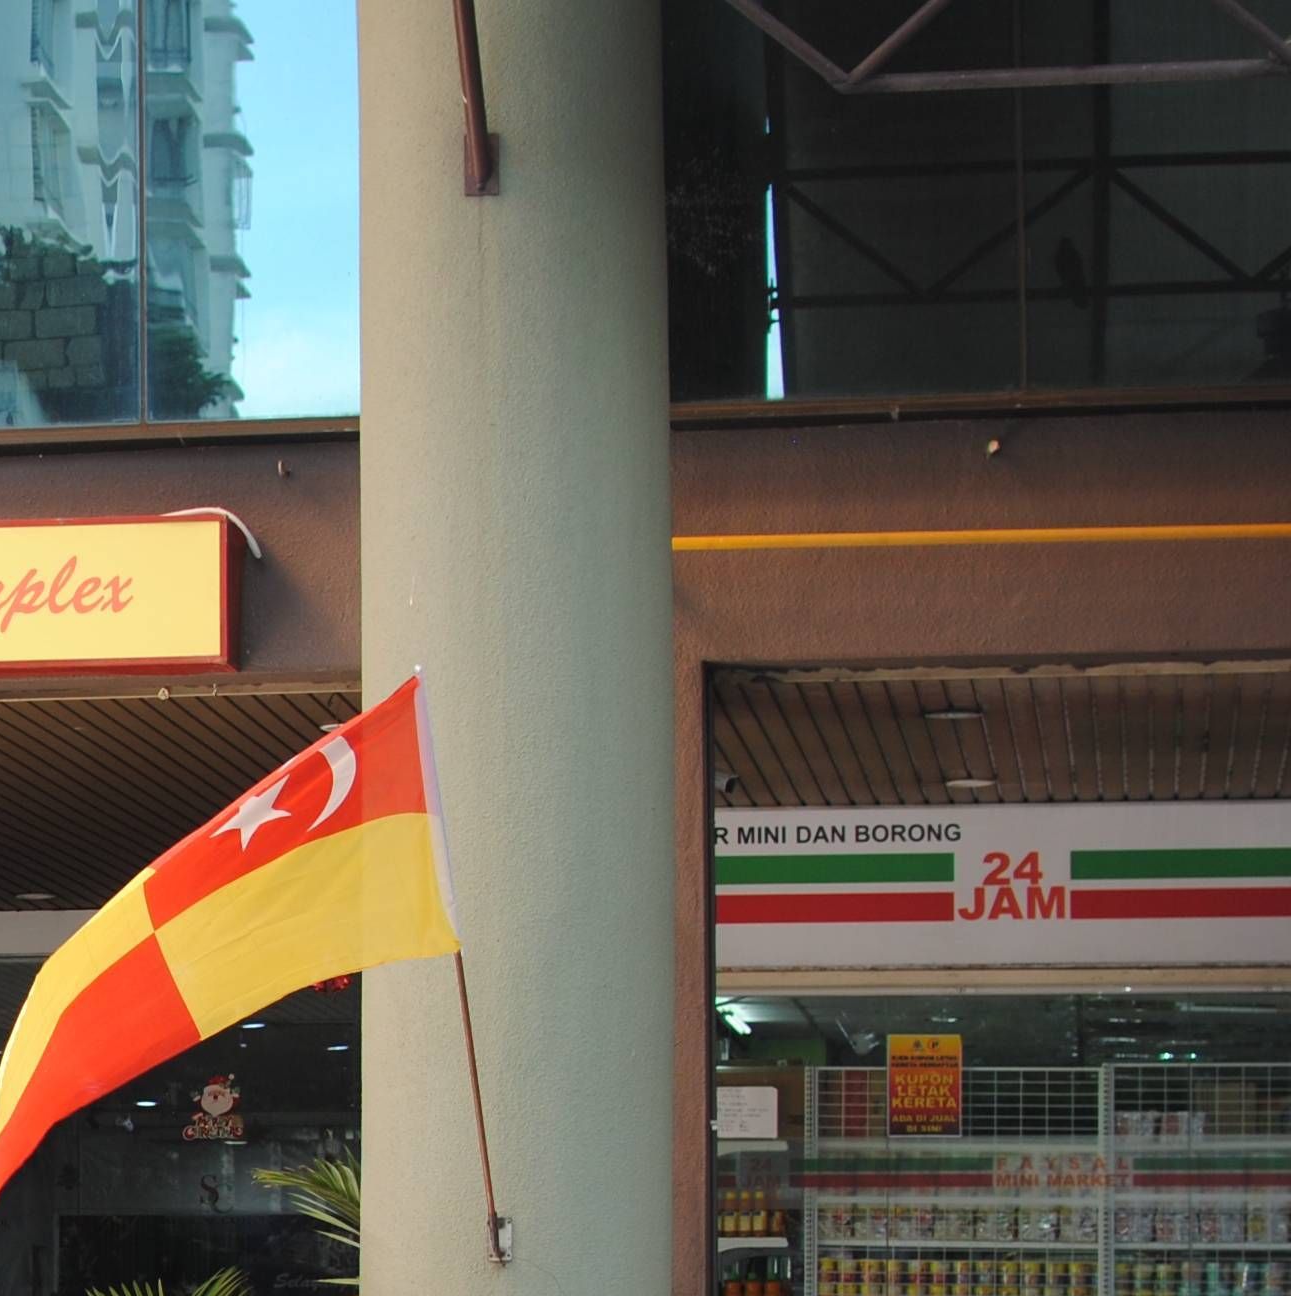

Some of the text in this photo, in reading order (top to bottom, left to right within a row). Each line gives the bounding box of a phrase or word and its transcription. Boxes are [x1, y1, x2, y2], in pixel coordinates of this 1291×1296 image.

[737, 826, 786, 844] MINI
[796, 825, 846, 843] DAN
[855, 823, 962, 842] BORONG
[983, 851, 1043, 885] 24
[958, 886, 1066, 921] JAM
[894, 1074, 954, 1085] KUPON
[897, 1086, 951, 1097] LETAK
[891, 1097, 957, 1108] KERETA
